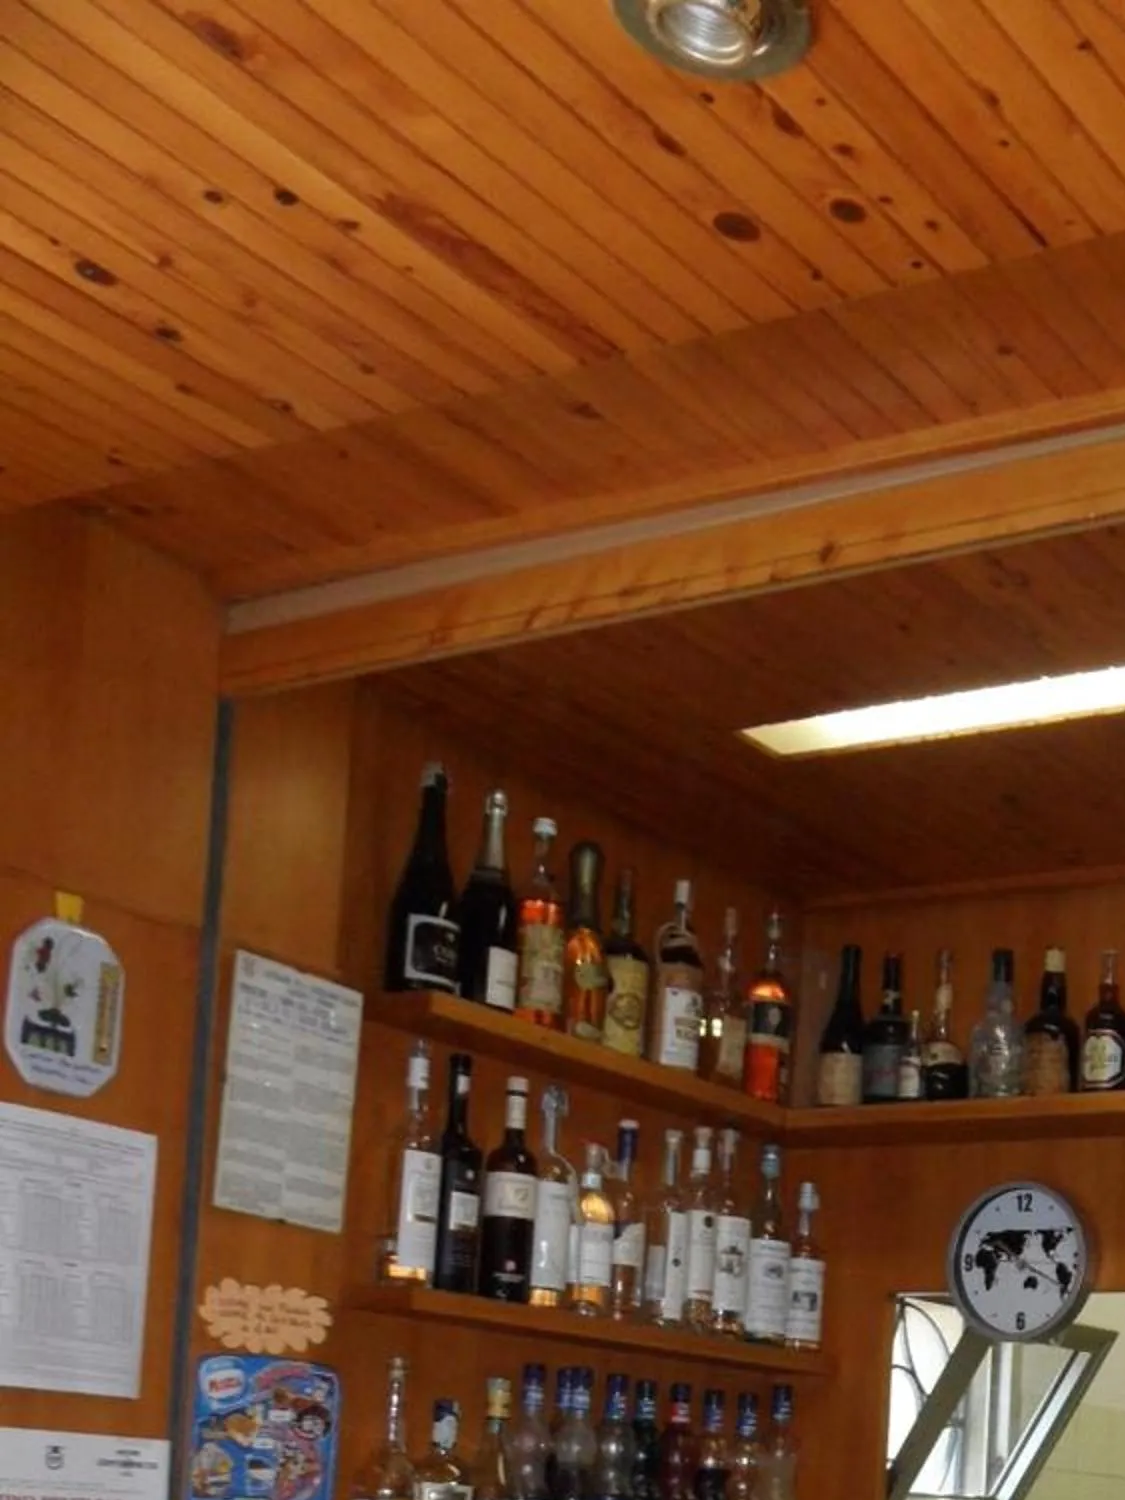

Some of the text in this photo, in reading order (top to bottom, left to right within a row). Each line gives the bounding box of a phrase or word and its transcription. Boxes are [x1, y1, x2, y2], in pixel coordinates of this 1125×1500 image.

[1016, 1192, 1034, 1213] 12
[964, 1253, 974, 1272] 9
[1015, 1312, 1025, 1331] 6
